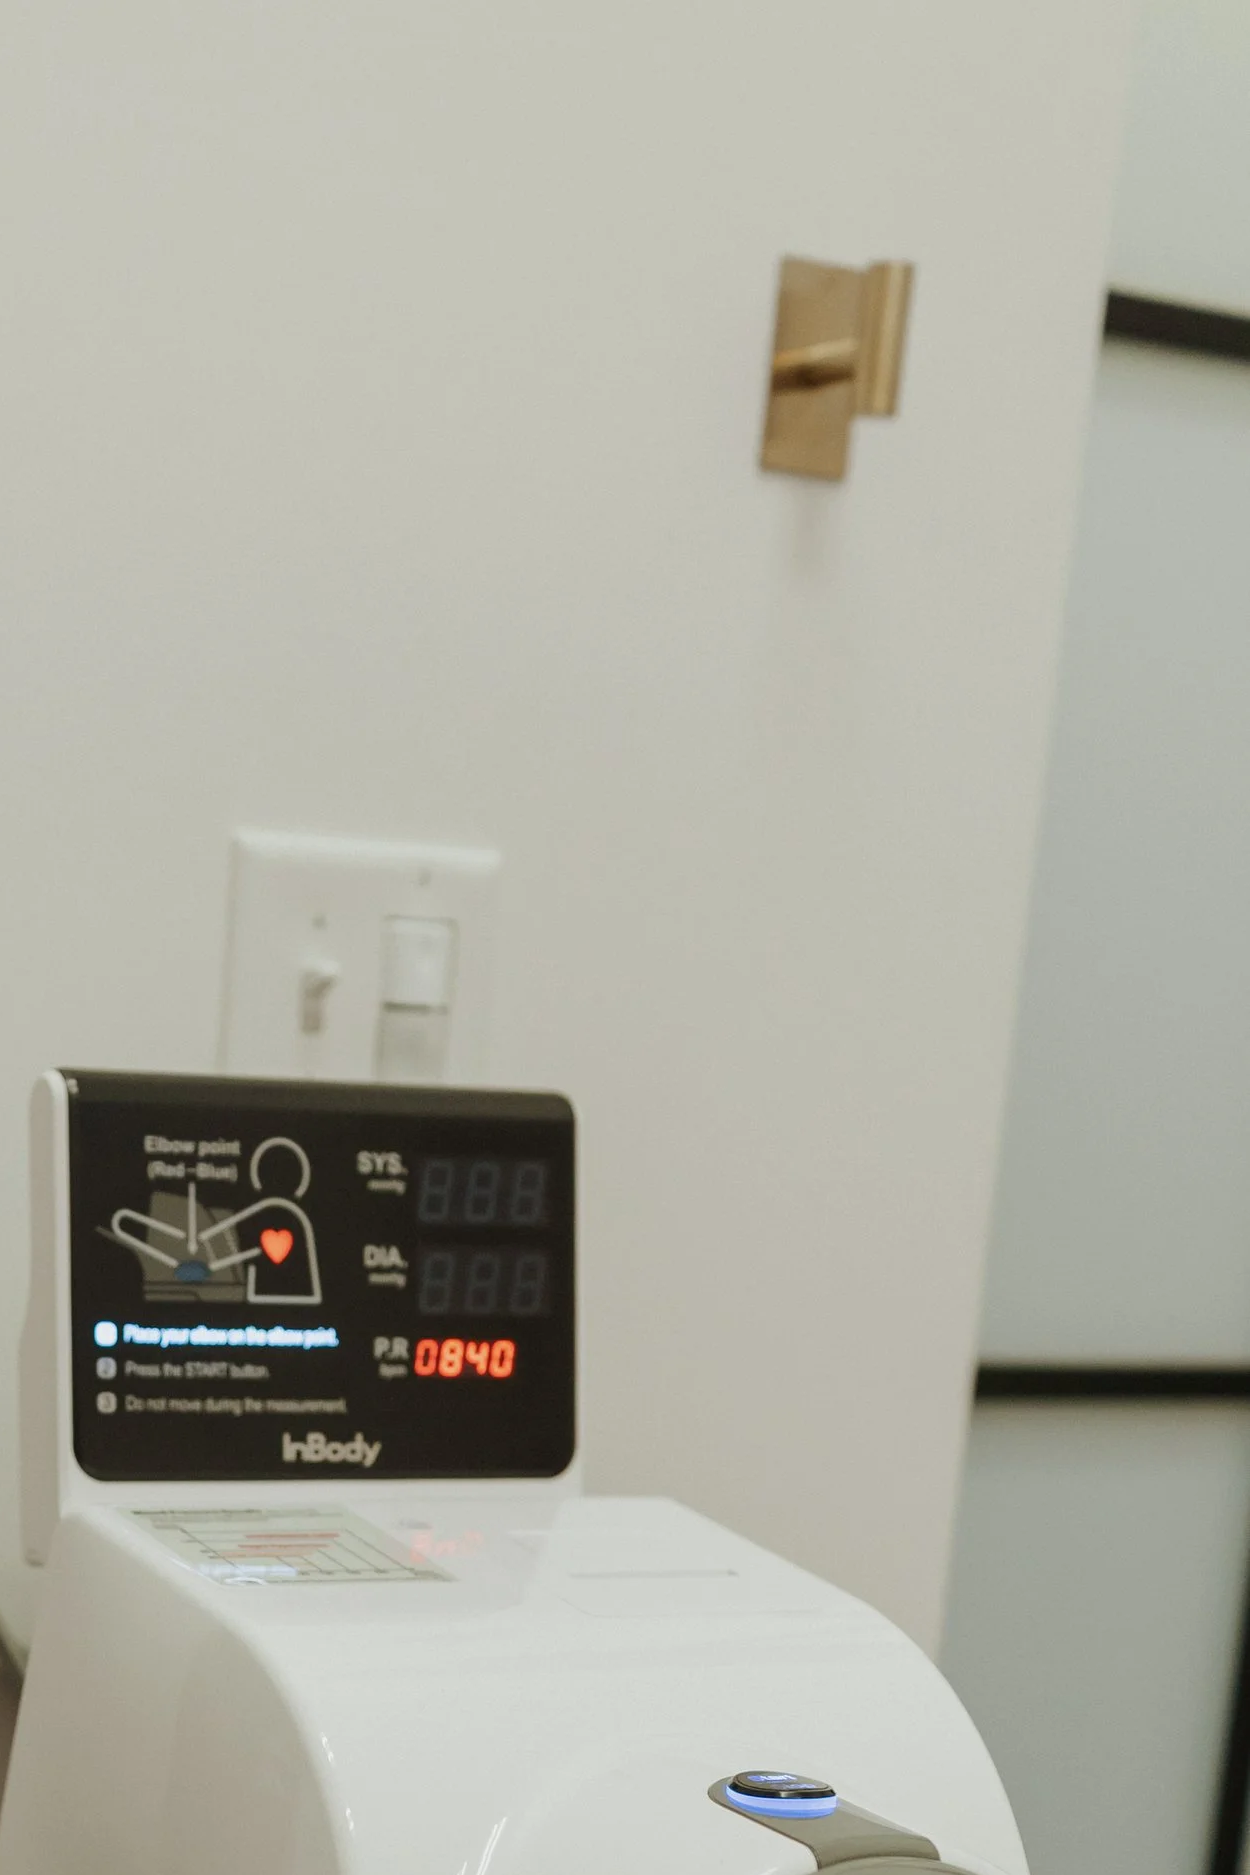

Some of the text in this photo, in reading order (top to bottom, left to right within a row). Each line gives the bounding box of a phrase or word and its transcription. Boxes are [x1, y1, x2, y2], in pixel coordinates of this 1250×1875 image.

[144, 1135, 240, 1157] Elbow point
[357, 1150, 409, 1176] SYS.
[363, 1244, 409, 1268] DIA.
[125, 1360, 161, 1377] Press
[163, 1362, 183, 1378] the
[184, 1362, 228, 1379] START
[414, 1338, 516, 1378] 0840
[125, 1395, 145, 1411] Do
[147, 1397, 165, 1411] not
[169, 1398, 201, 1412] move
[203, 1396, 243, 1416] during
[244, 1396, 263, 1412] the
[282, 1432, 382, 1467] InBody
